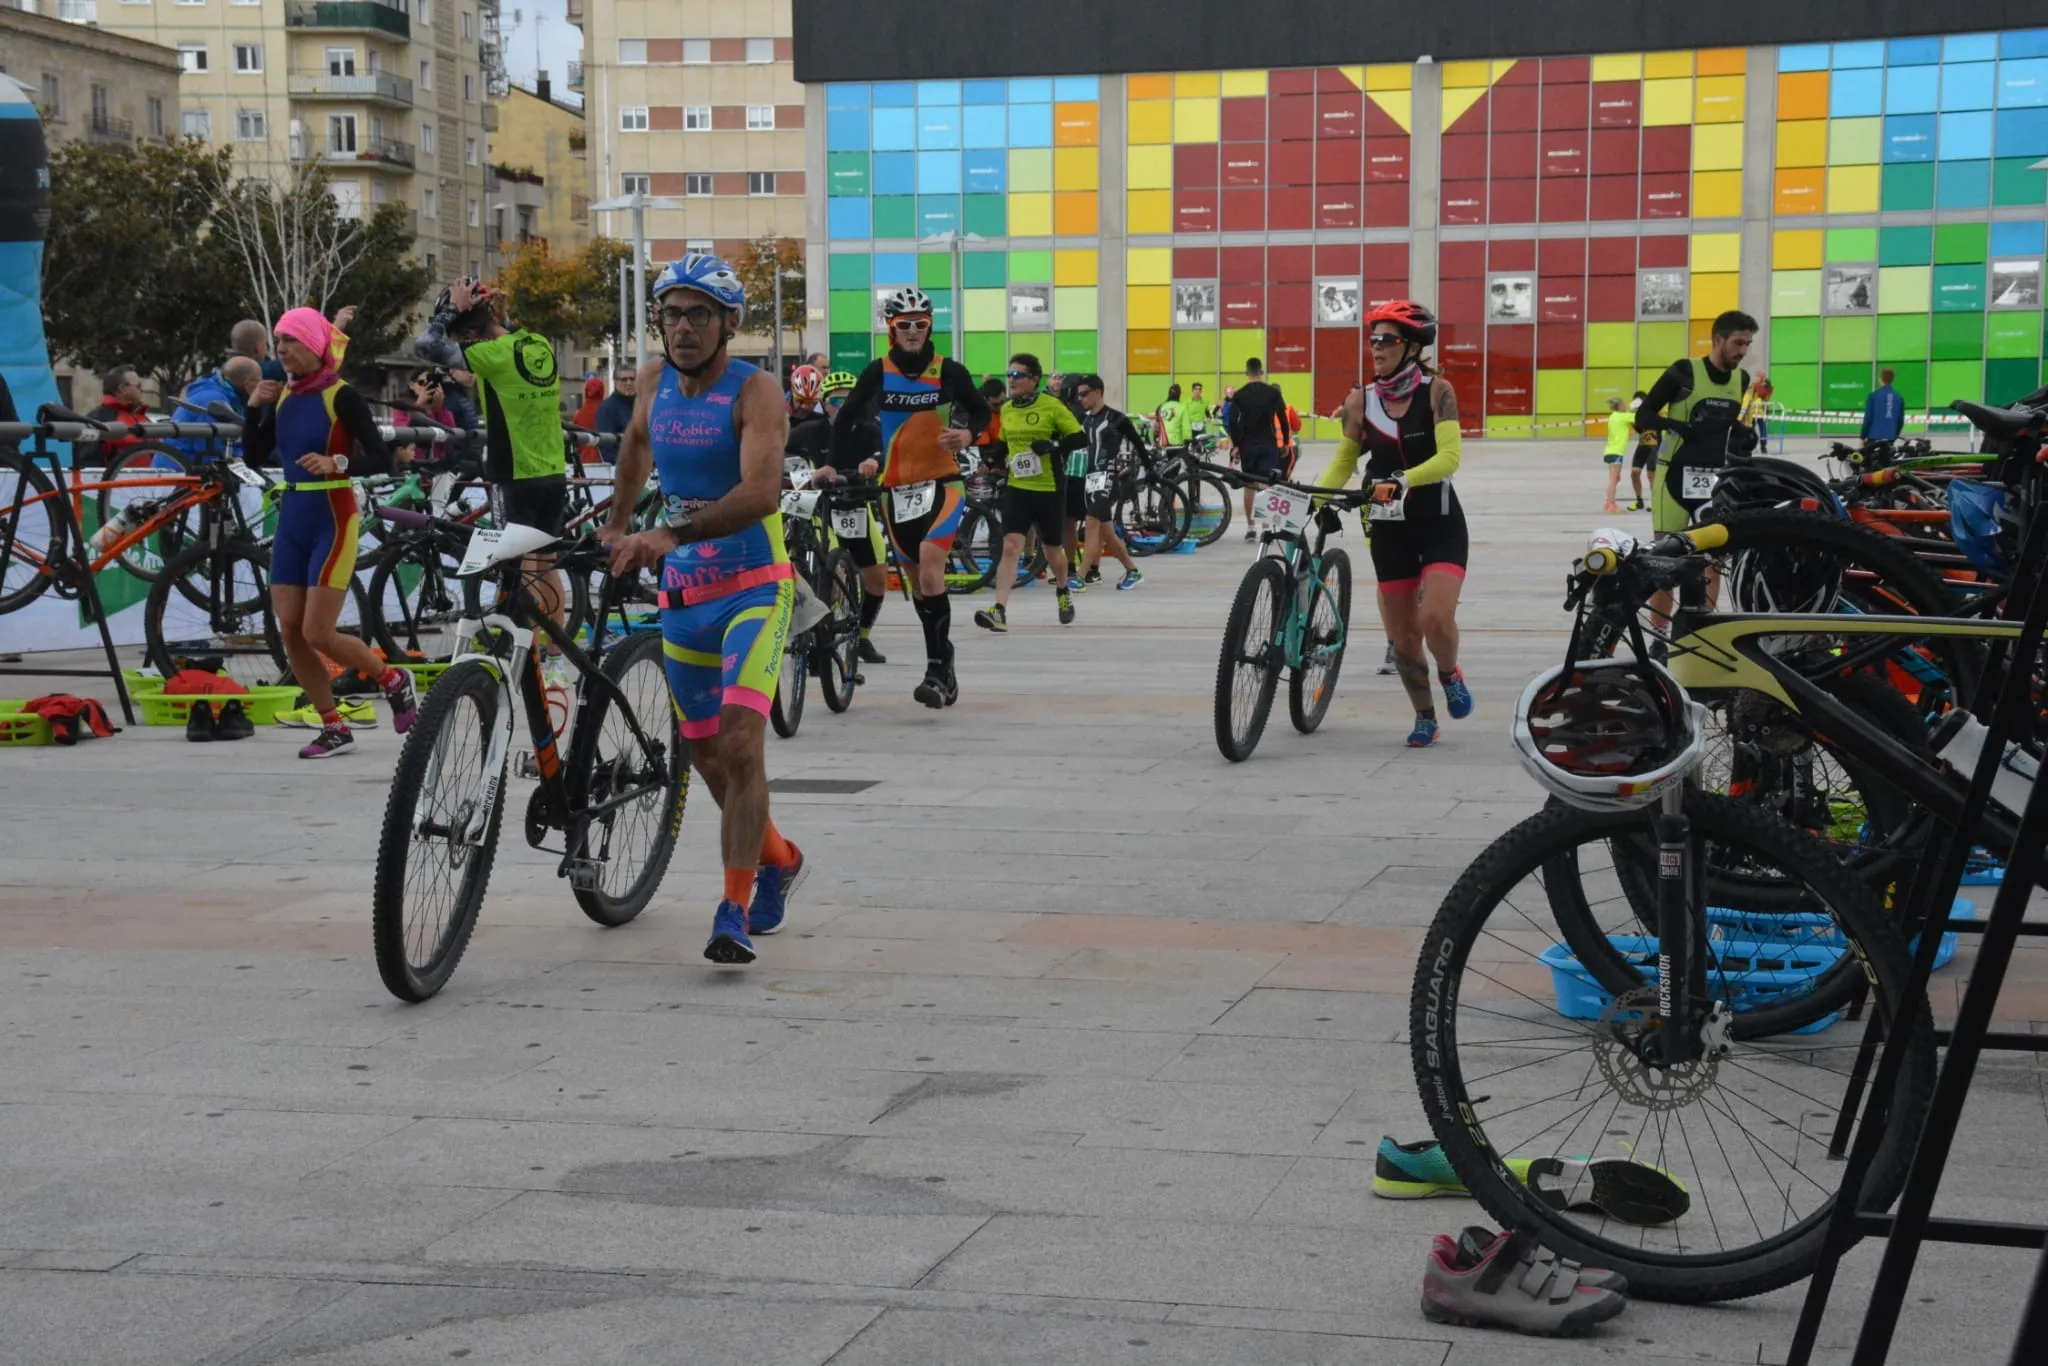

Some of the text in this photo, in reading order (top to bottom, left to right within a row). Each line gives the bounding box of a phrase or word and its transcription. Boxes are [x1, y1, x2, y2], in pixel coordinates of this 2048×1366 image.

[884, 392, 940, 405] X-TIGER
[668, 420, 721, 436] Robles
[1692, 476, 1710, 488] 23
[904, 493, 923, 509] 73
[1267, 496, 1291, 515] 38
[840, 518, 856, 529] 68
[1659, 953, 1672, 1017] ROCKSHOX
[1425, 937, 1455, 1069] SAGUARO
